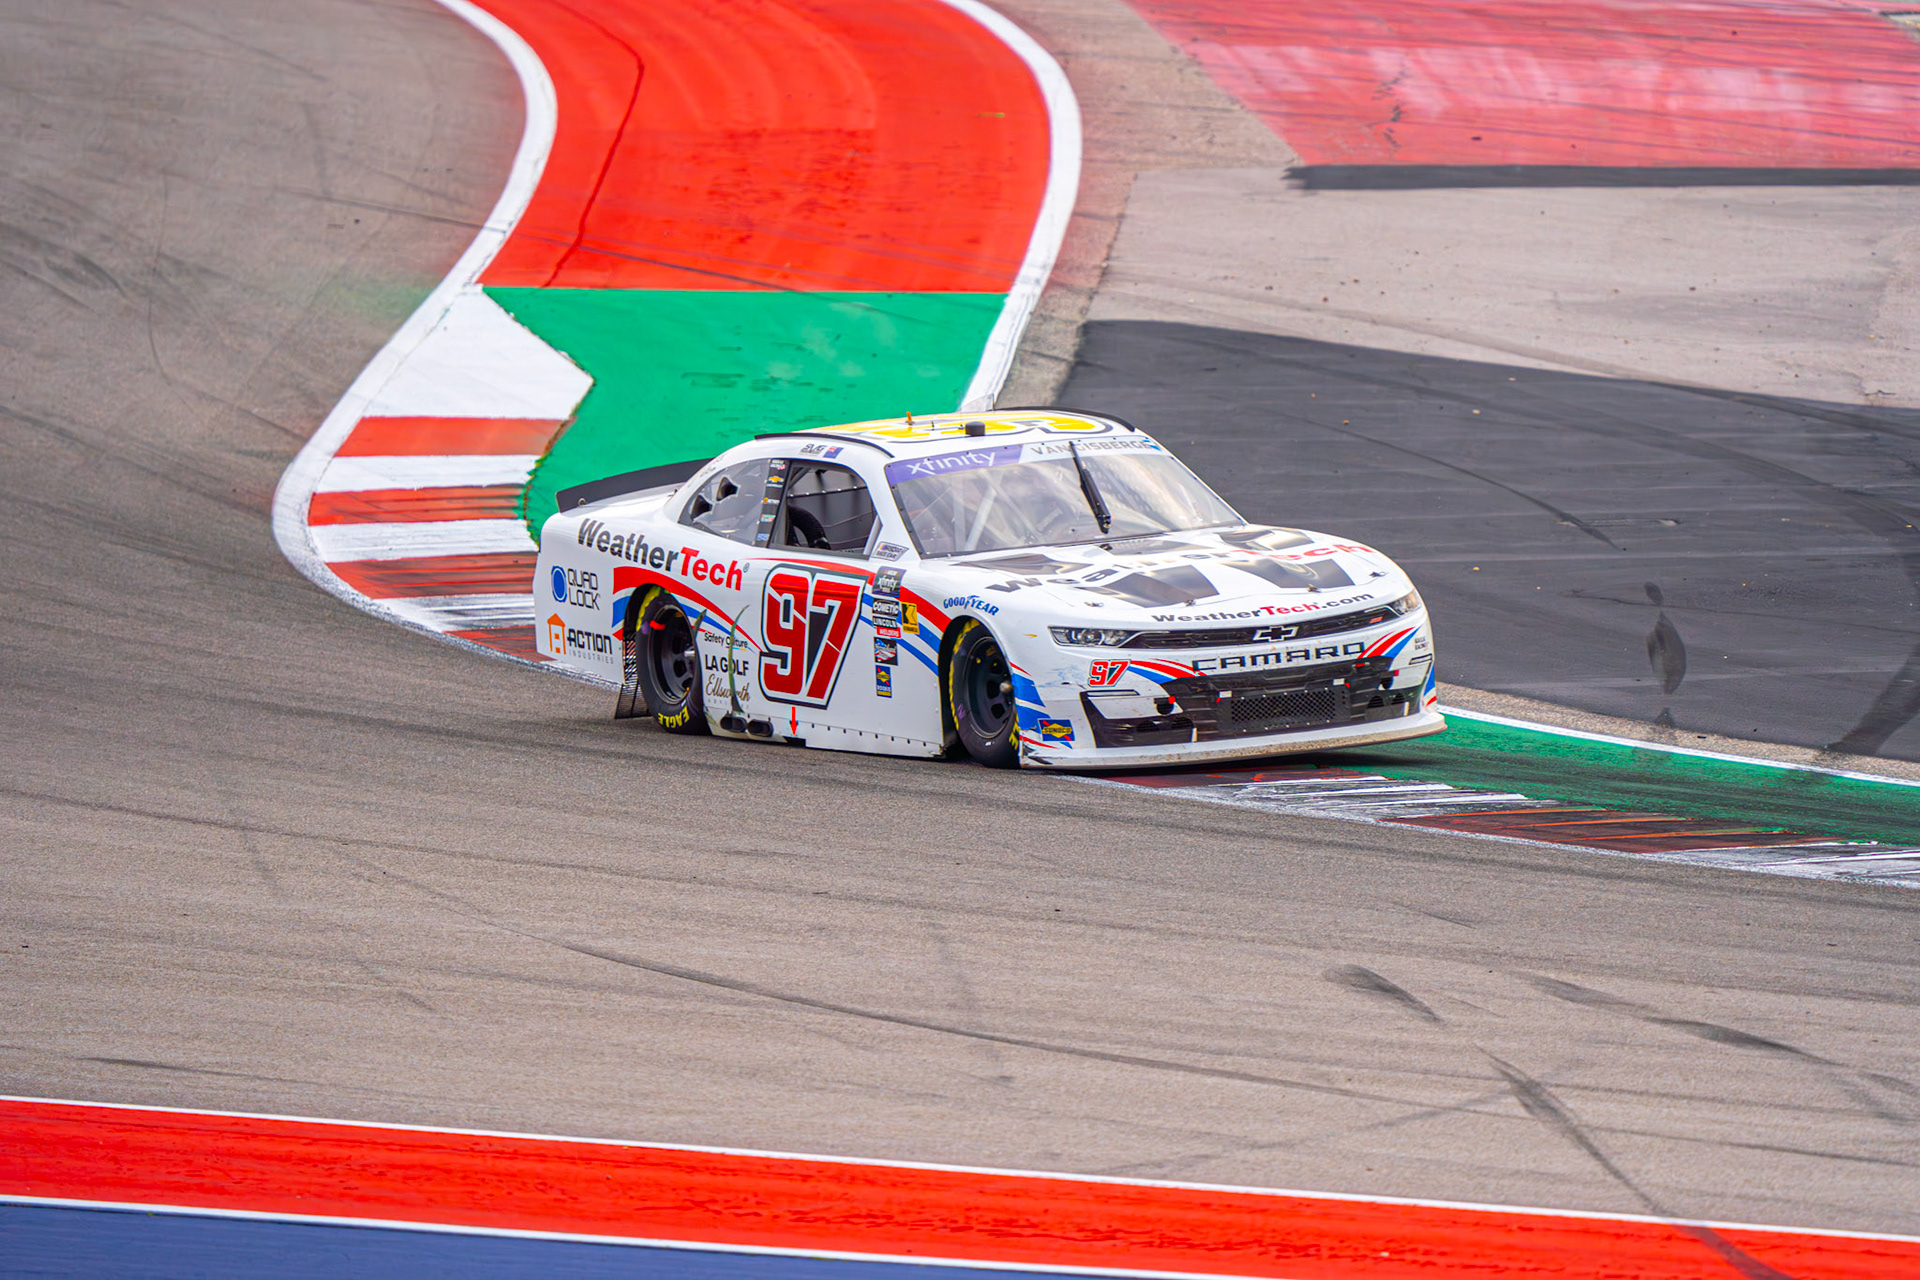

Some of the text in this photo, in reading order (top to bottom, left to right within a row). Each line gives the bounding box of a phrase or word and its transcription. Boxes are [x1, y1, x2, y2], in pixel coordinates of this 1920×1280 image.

[906, 450, 997, 476] xfinity
[567, 568, 598, 591] QUAD
[568, 587, 600, 611] LOCK
[1151, 592, 1375, 622] WeatherTech.com
[873, 616, 898, 628] LINCOLN
[567, 628, 613, 655] ACTION
[758, 563, 870, 709] 97
[1191, 641, 1365, 672] CAMARO
[1087, 658, 1132, 688] 97
[657, 705, 691, 729] EAGLE
